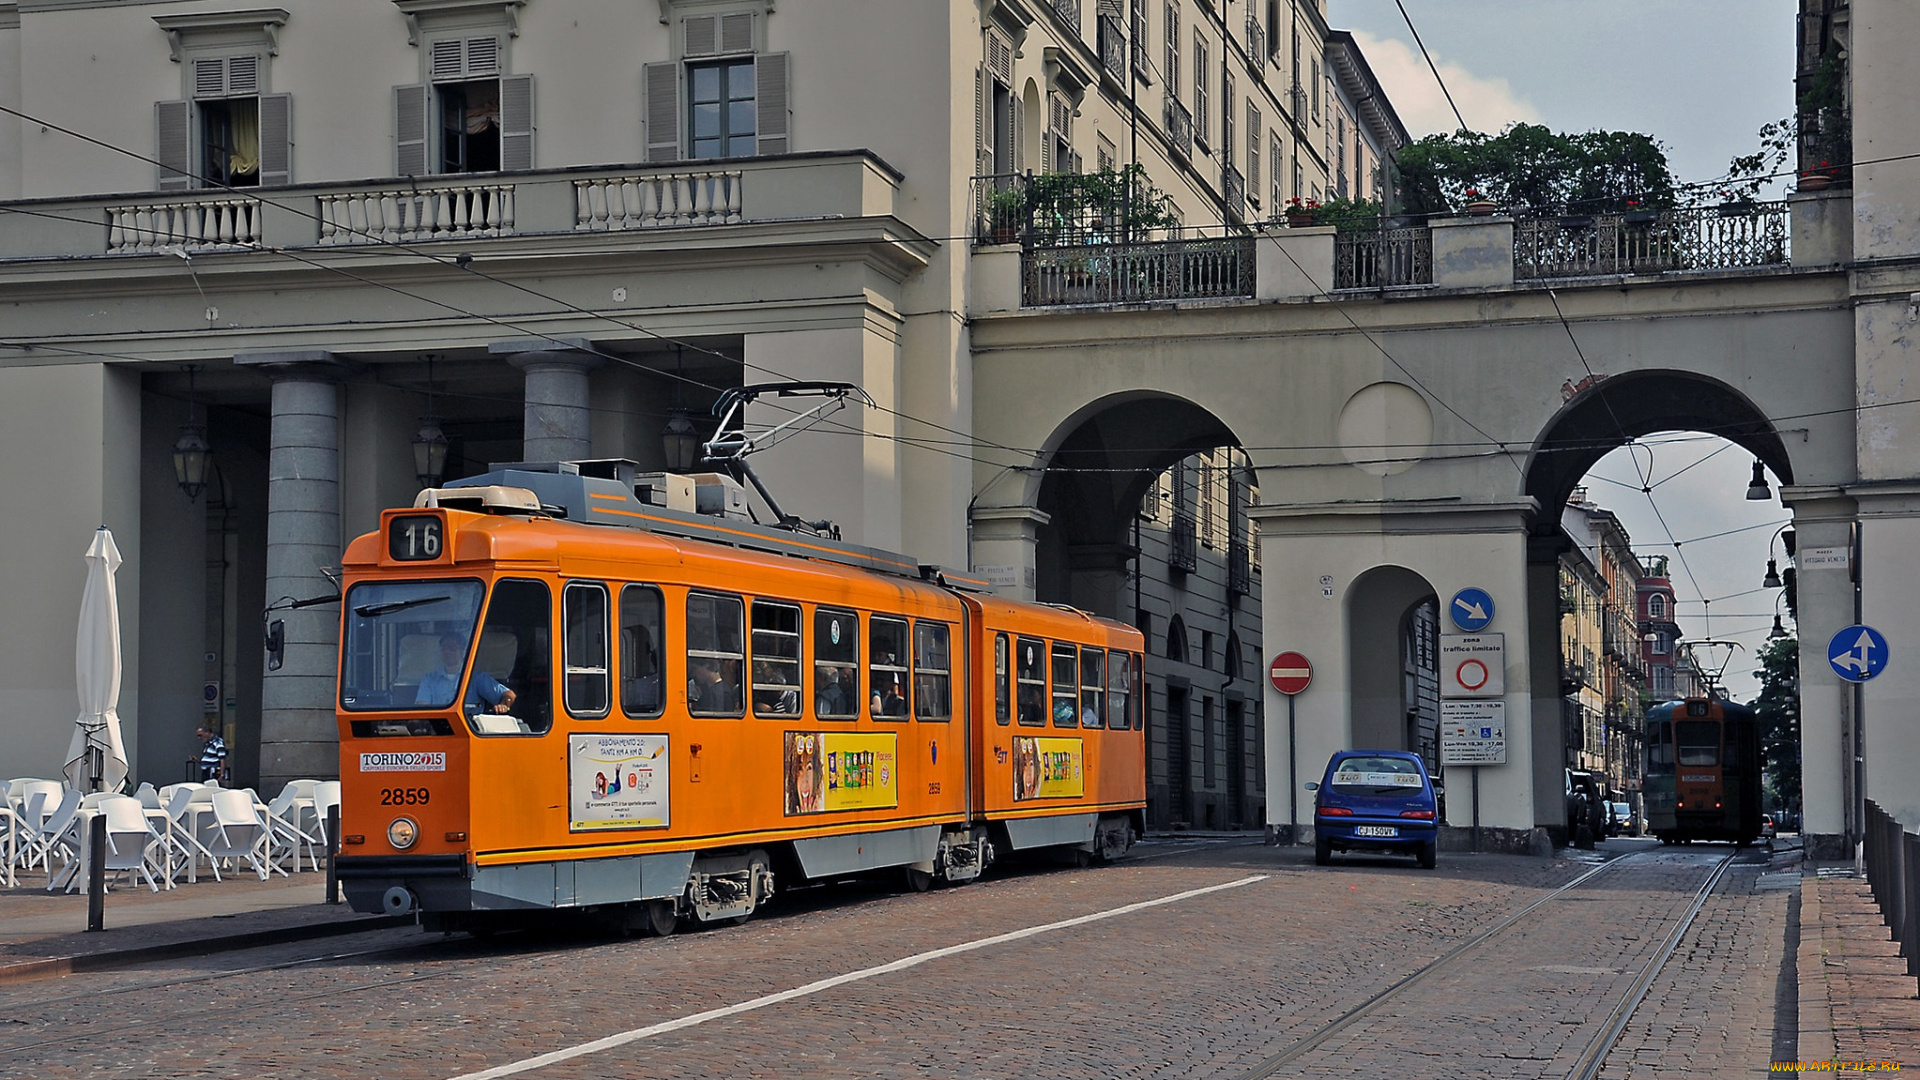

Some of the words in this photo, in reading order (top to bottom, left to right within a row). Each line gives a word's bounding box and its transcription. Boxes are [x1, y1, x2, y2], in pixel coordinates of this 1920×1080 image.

[405, 524, 438, 556] 16
[363, 753, 443, 766] TORINO2015
[380, 787, 430, 806] 2859
